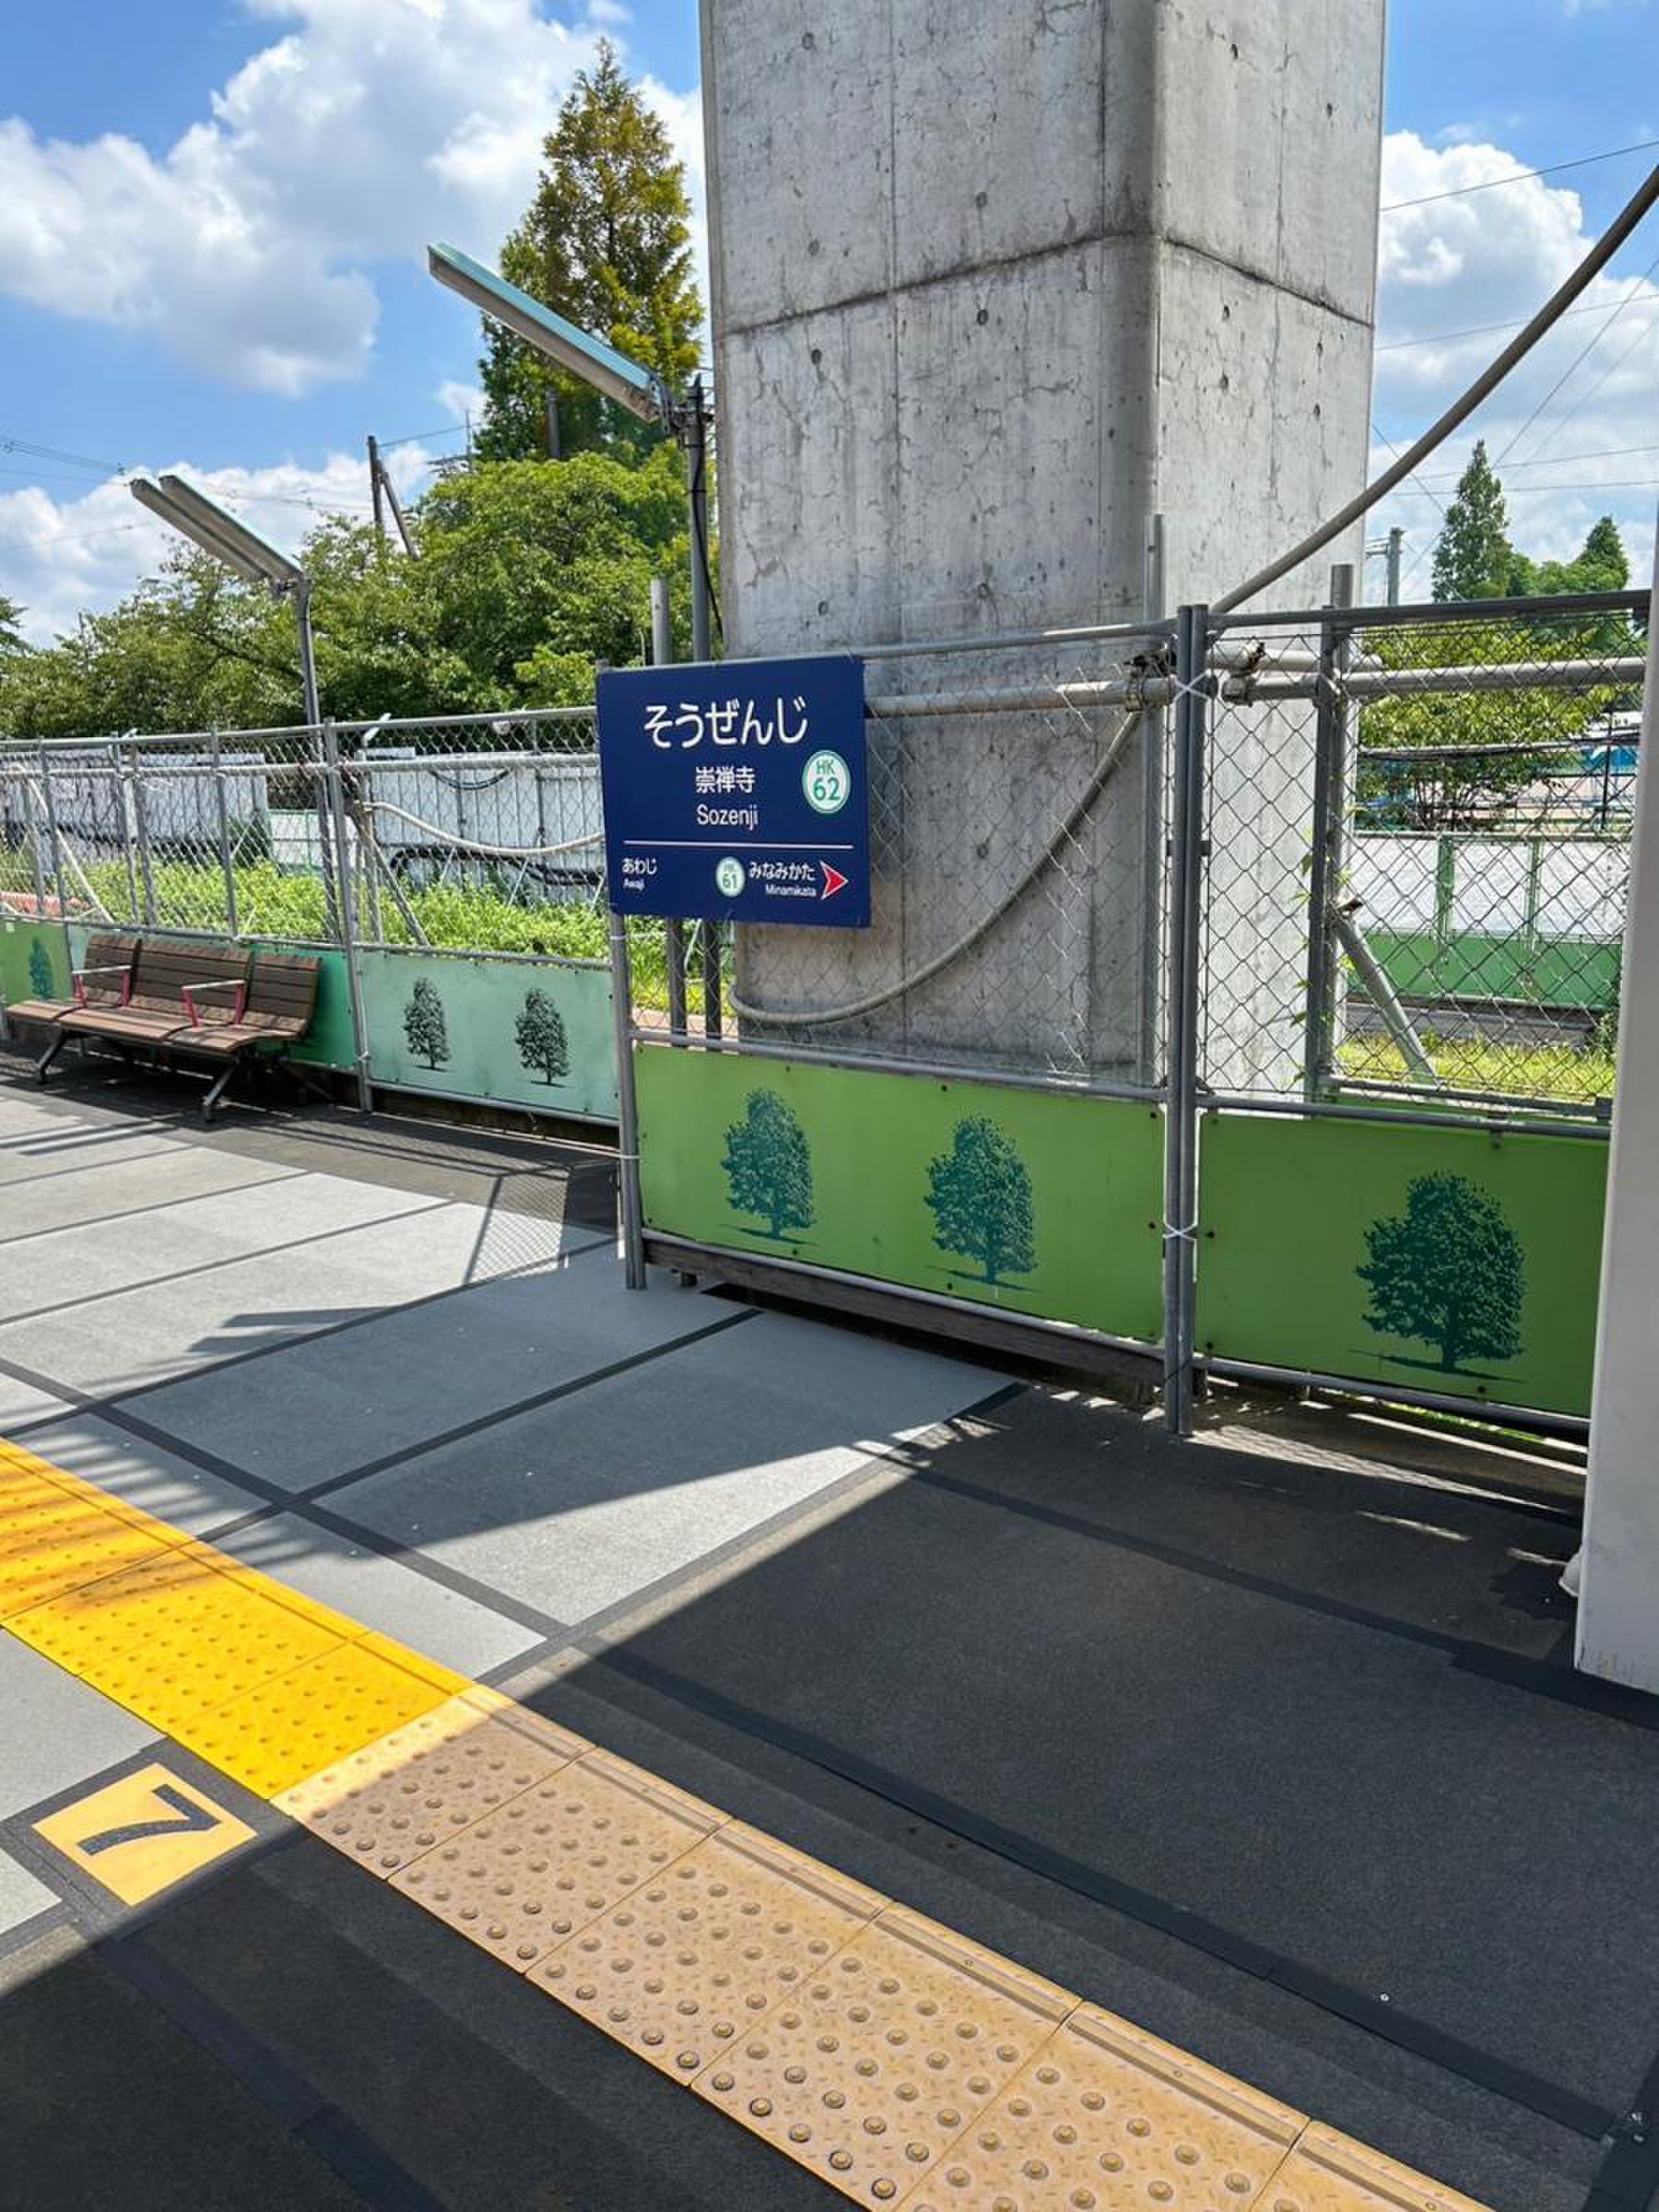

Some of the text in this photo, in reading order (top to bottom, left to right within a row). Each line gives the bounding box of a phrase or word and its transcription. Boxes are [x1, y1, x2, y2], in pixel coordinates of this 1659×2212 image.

[644, 696, 808, 748] そうぜんじ
[816, 760, 836, 775] HK
[695, 766, 756, 794] 崇禅寺
[813, 777, 841, 801] 62
[696, 804, 759, 830] Sozenji
[621, 857, 657, 876] あわじ
[748, 861, 816, 881] みなみかた
[722, 873, 738, 888] 61
[765, 884, 817, 897] Minamikata
[76, 1783, 222, 1856] 7
